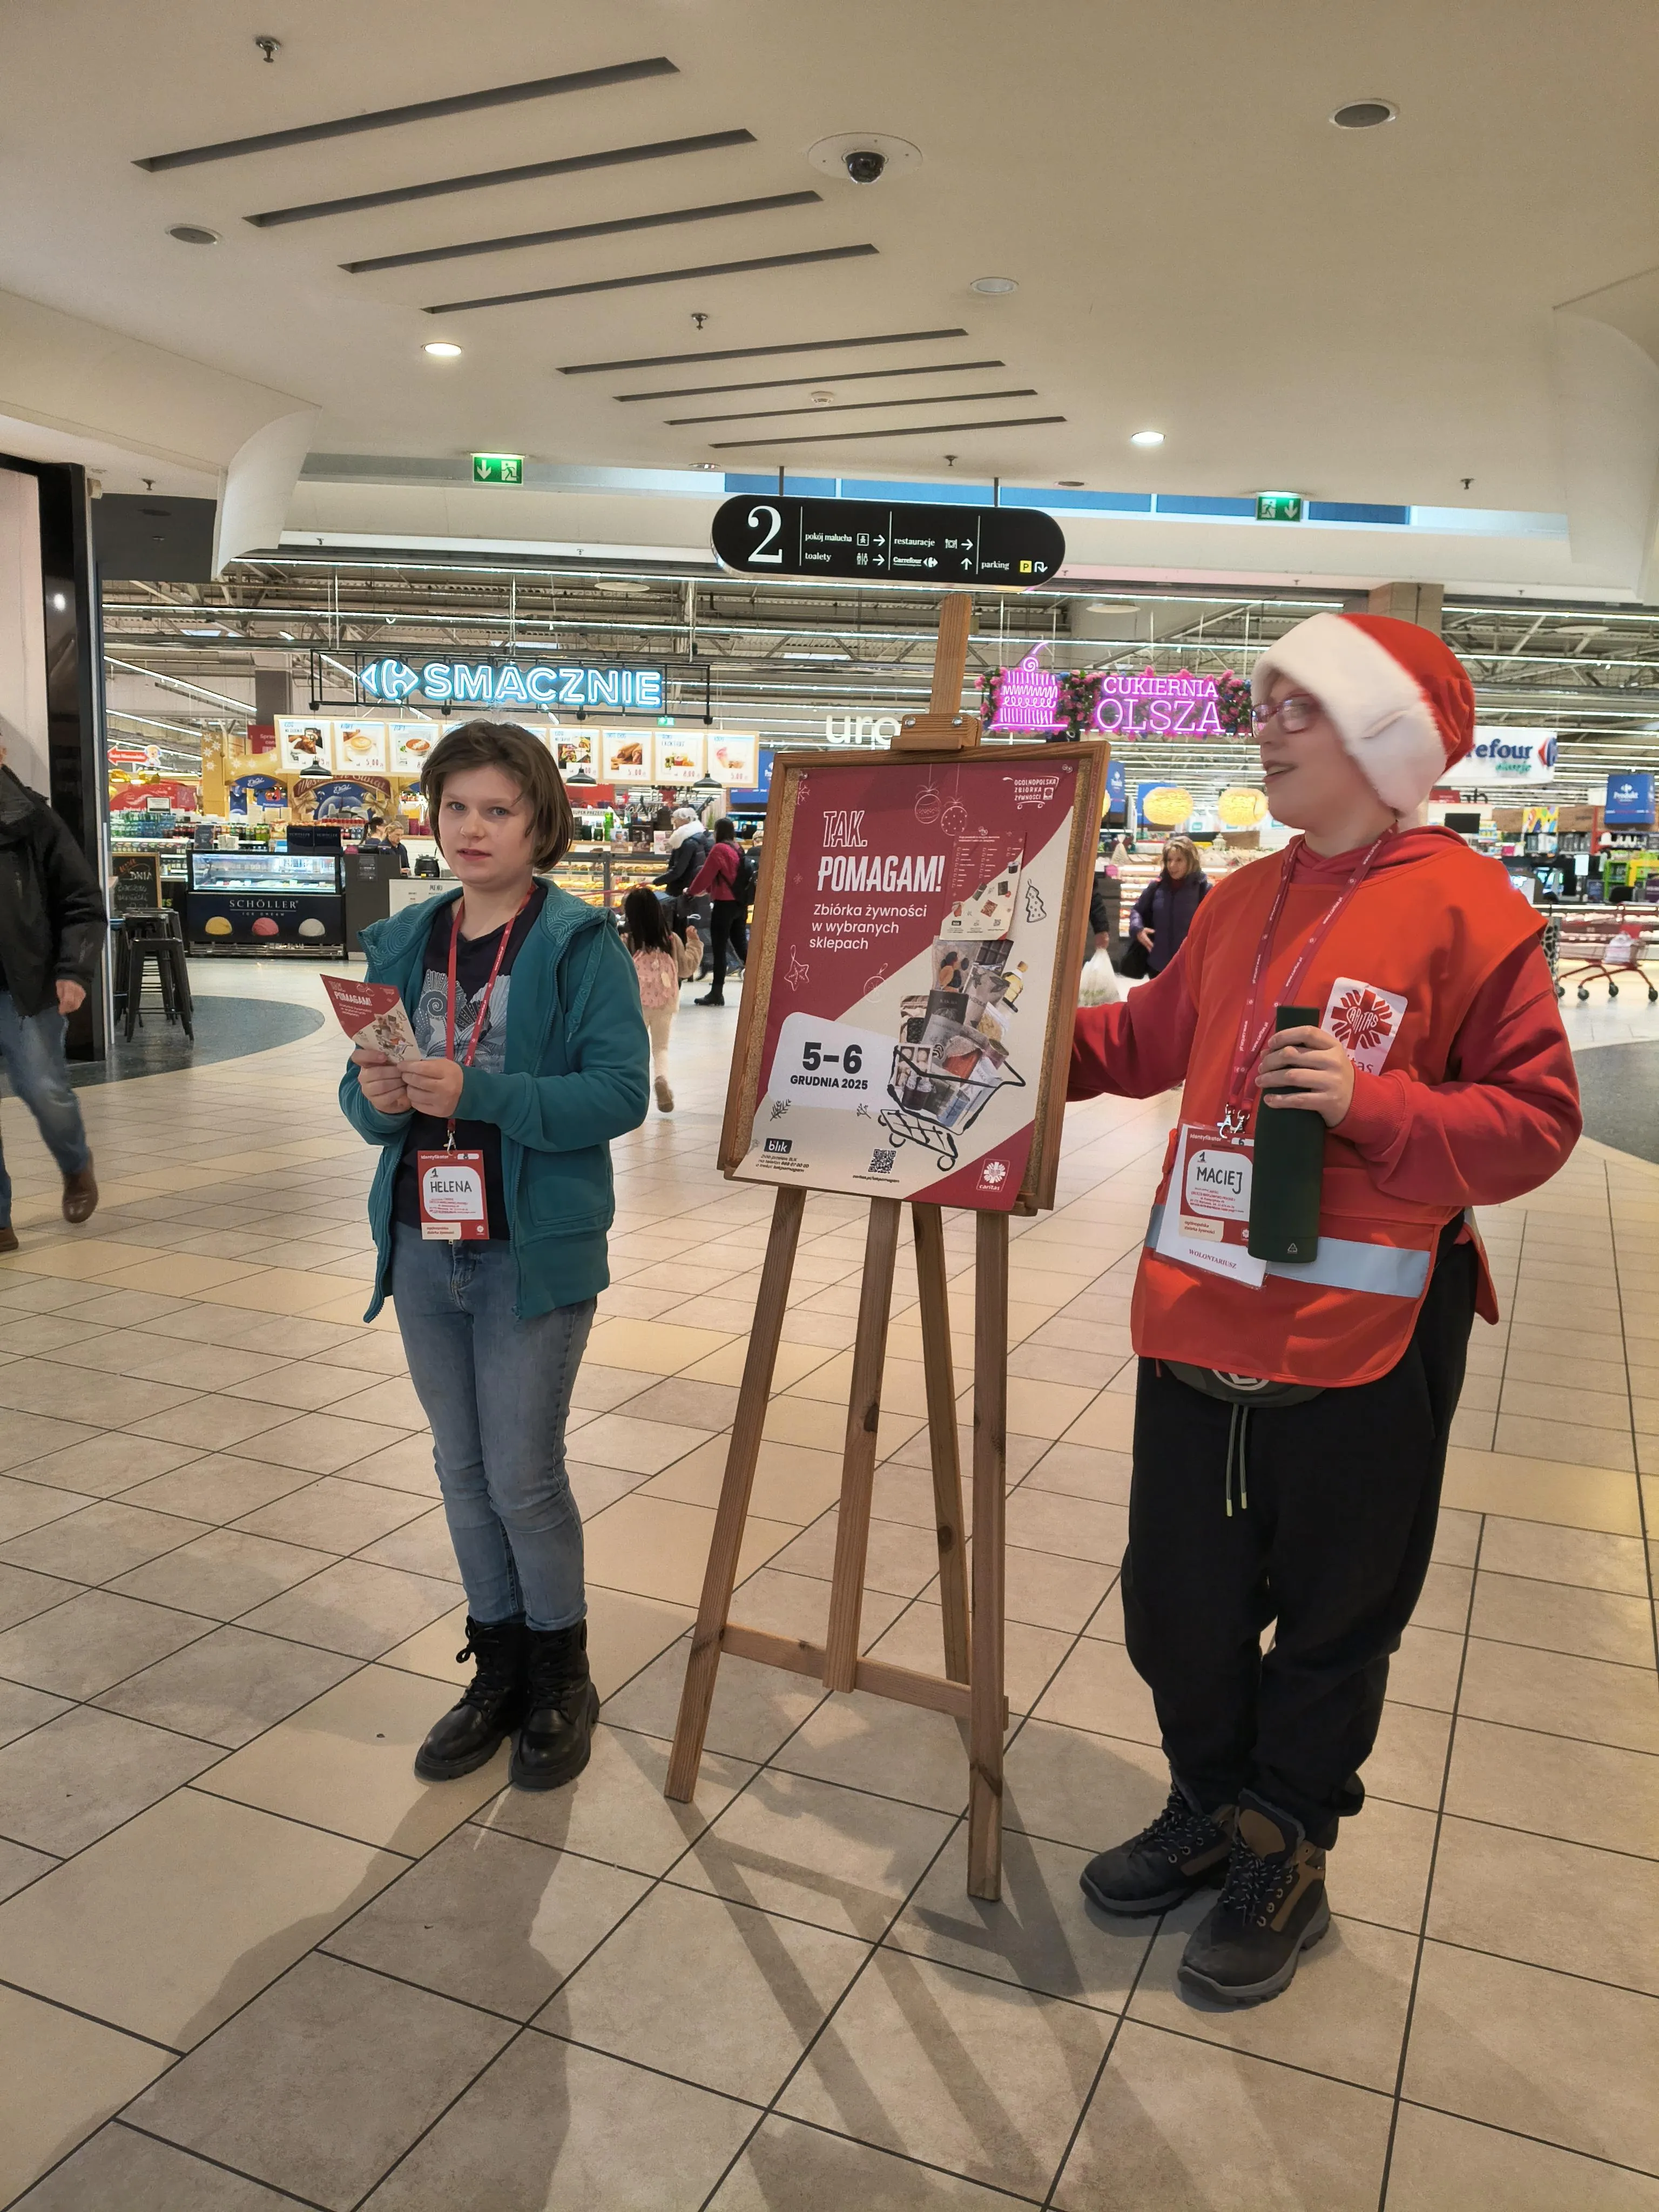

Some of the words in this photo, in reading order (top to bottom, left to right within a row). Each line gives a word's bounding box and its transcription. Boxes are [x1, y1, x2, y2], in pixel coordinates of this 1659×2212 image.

[747, 505, 783, 563] 2
[805, 532, 824, 542] pokój
[825, 534, 852, 542] malucha
[894, 538, 935, 547] restauracje
[805, 552, 832, 562] toalety
[893, 556, 922, 564] Carrefour
[981, 561, 1010, 570] parking
[423, 662, 664, 709] SMACZNIE
[1103, 676, 1219, 698] CUKIERNIA
[1096, 698, 1226, 732] OLSZA
[1466, 738, 1533, 759] efour
[823, 810, 868, 847] TAK.
[817, 855, 945, 892] POMAGAM!
[813, 903, 862, 916] Zbiórka
[865, 904, 927, 920] żywności
[812, 922, 822, 932] w
[825, 920, 899, 937] wybranych
[809, 936, 869, 952] sklepach
[790, 1075, 839, 1088] GRUDNIA
[841, 1078, 868, 1090] 2025
[768, 1140, 787, 1152] blik
[1190, 1134, 1222, 1142] Identyfikator
[430, 1181, 473, 1193] HELENA
[1197, 1166, 1243, 1195] MACIEJ
[1189, 1249, 1237, 1269] WOLONTARIUSZ
